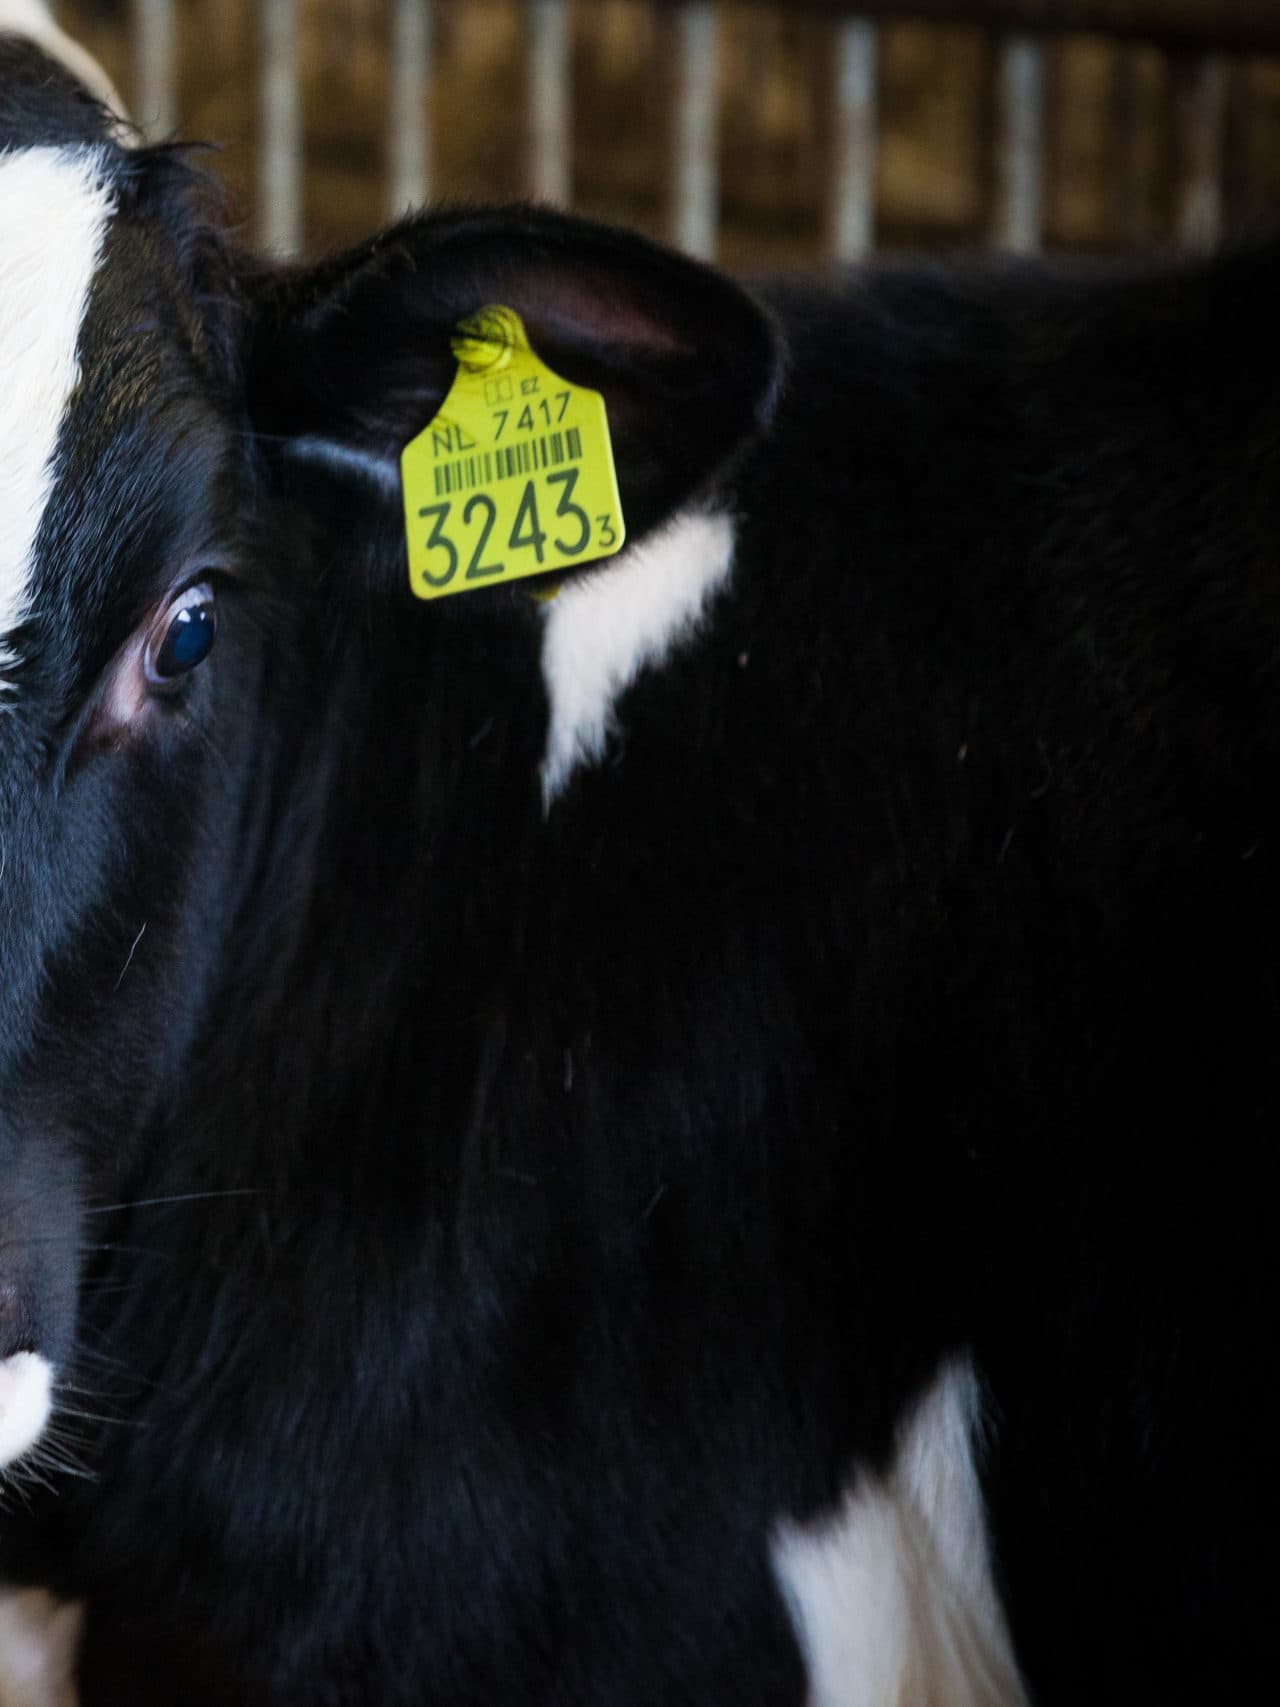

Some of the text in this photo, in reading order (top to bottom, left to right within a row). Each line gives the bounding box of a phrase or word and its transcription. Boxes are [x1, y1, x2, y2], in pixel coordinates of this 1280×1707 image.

[520, 376, 540, 396] EZ
[431, 391, 572, 457] NL 7417
[418, 467, 617, 587] 3243 3
